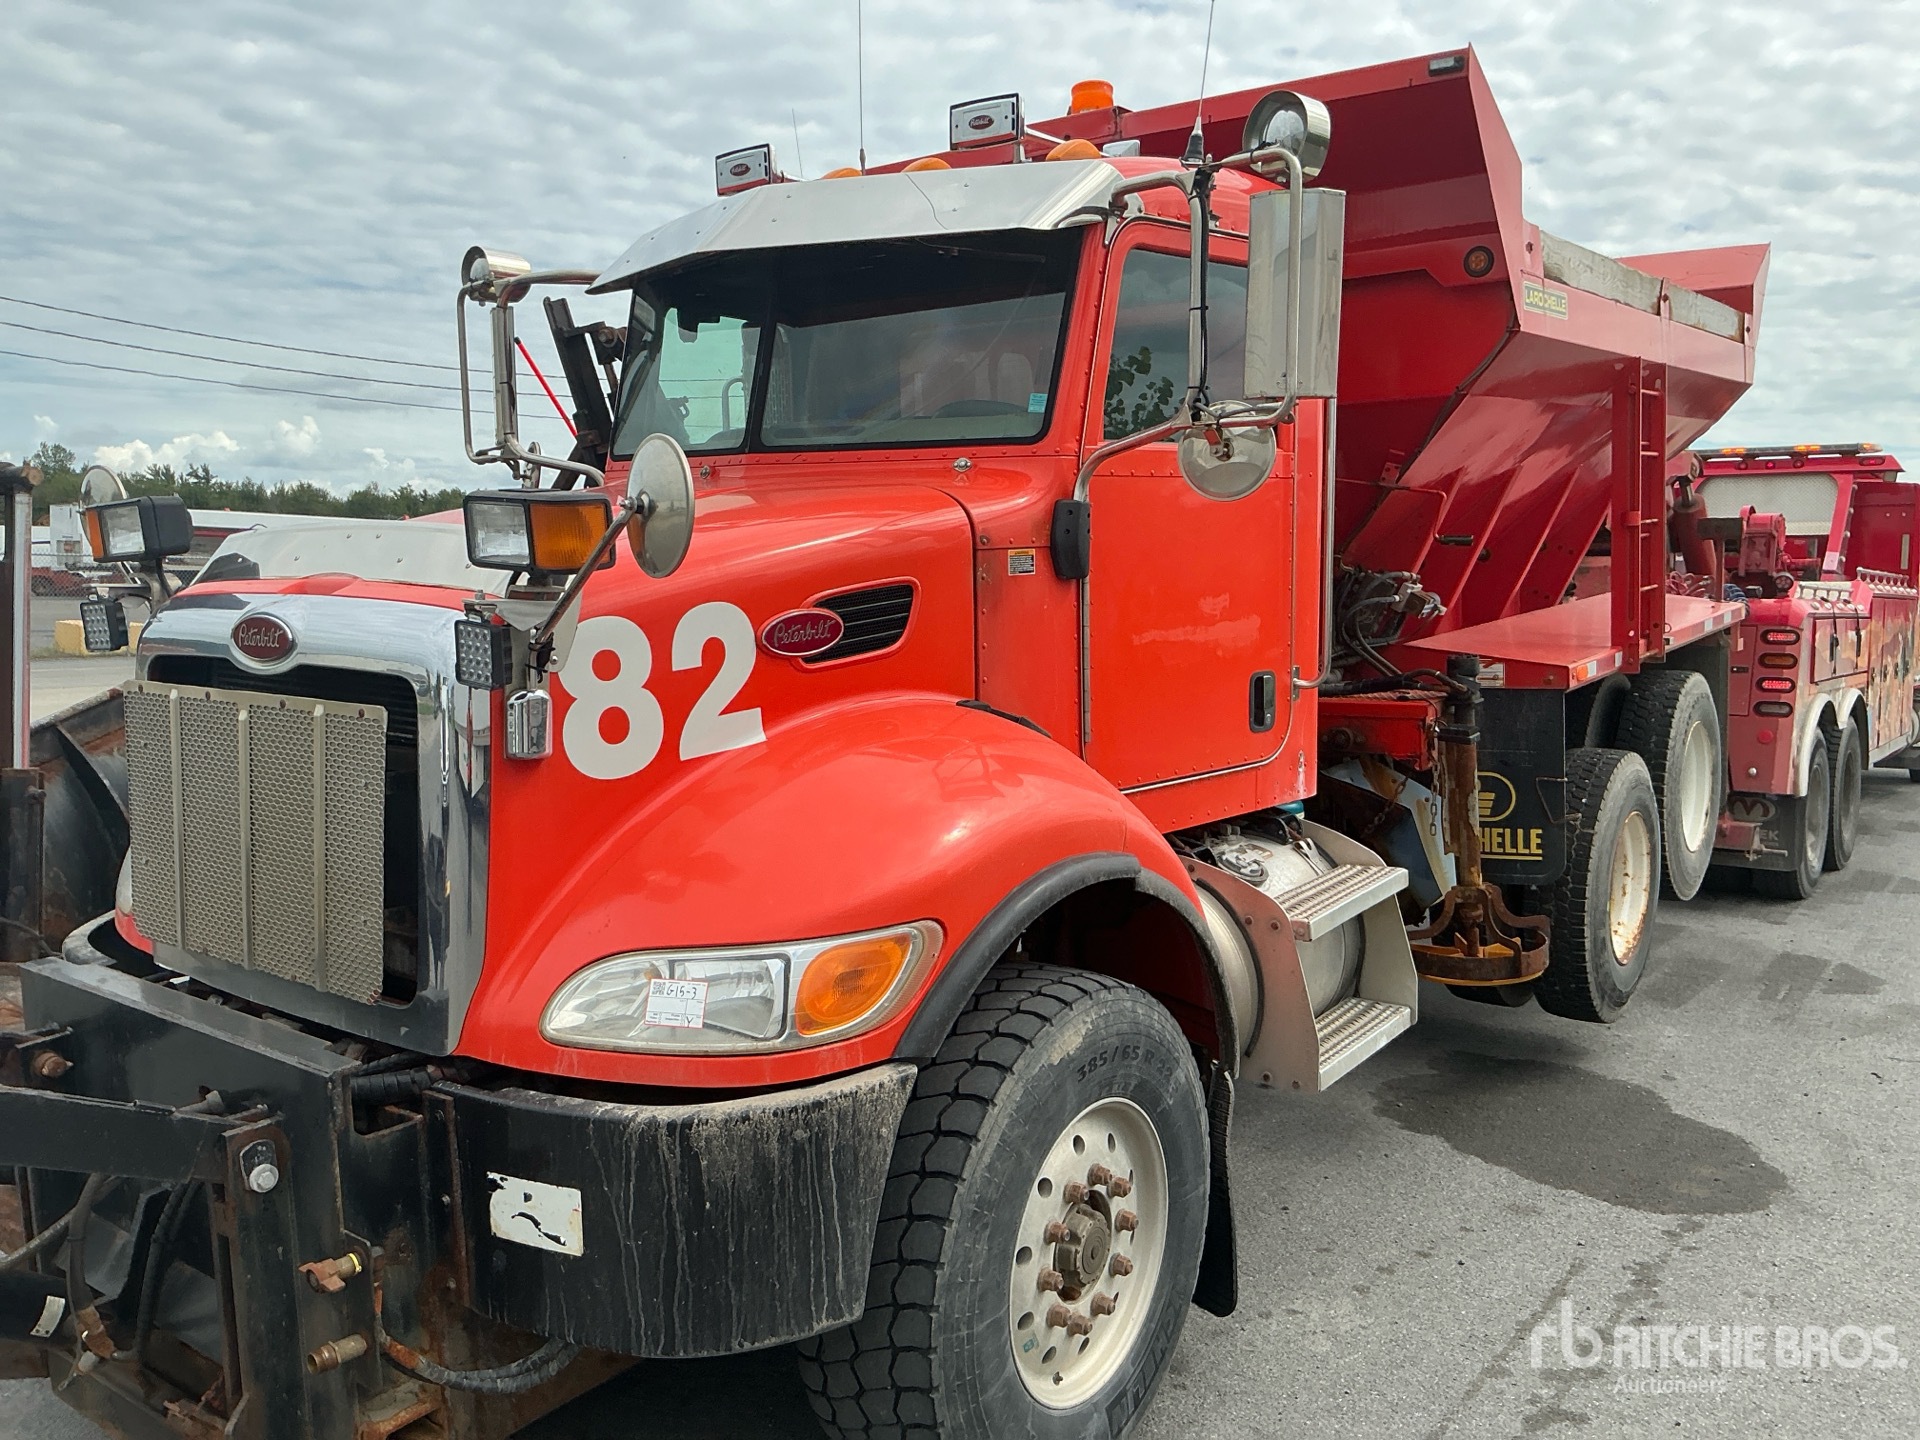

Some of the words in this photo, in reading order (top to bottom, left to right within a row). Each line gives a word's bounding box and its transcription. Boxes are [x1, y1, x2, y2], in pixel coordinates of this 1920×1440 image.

[238, 623, 283, 648] Peterbilt
[774, 619, 836, 647] Peterbilt
[558, 601, 768, 780] 82
[1480, 827, 1543, 854] HELLE
[666, 984, 697, 1000] G15-3
